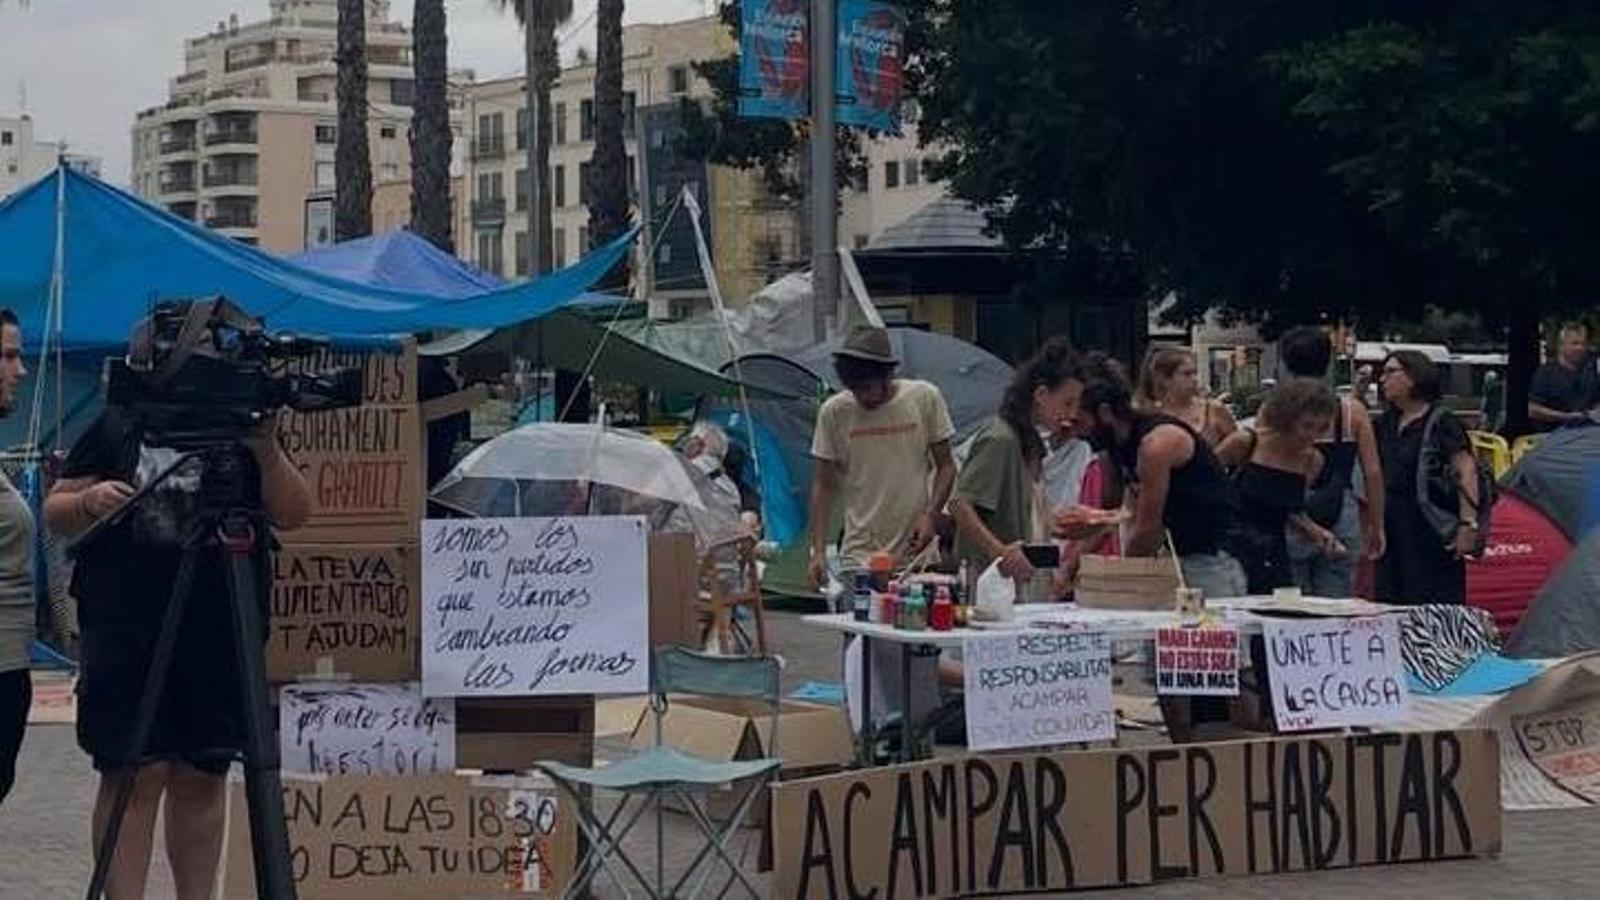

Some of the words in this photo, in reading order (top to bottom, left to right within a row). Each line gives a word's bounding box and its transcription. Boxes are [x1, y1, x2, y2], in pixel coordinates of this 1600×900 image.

[274, 557, 307, 580] LA
[309, 556, 394, 580] TEVA
[1367, 633, 1384, 661] A
[1321, 674, 1400, 711] CAUSA
[333, 792, 366, 831] A
[384, 794, 455, 834] LAS
[797, 756, 1074, 900] ACAMPAR
[1116, 746, 1225, 884] PER
[1243, 730, 1474, 873] HABITAR
[330, 843, 412, 878] DEJA
[420, 846, 459, 873] TU
